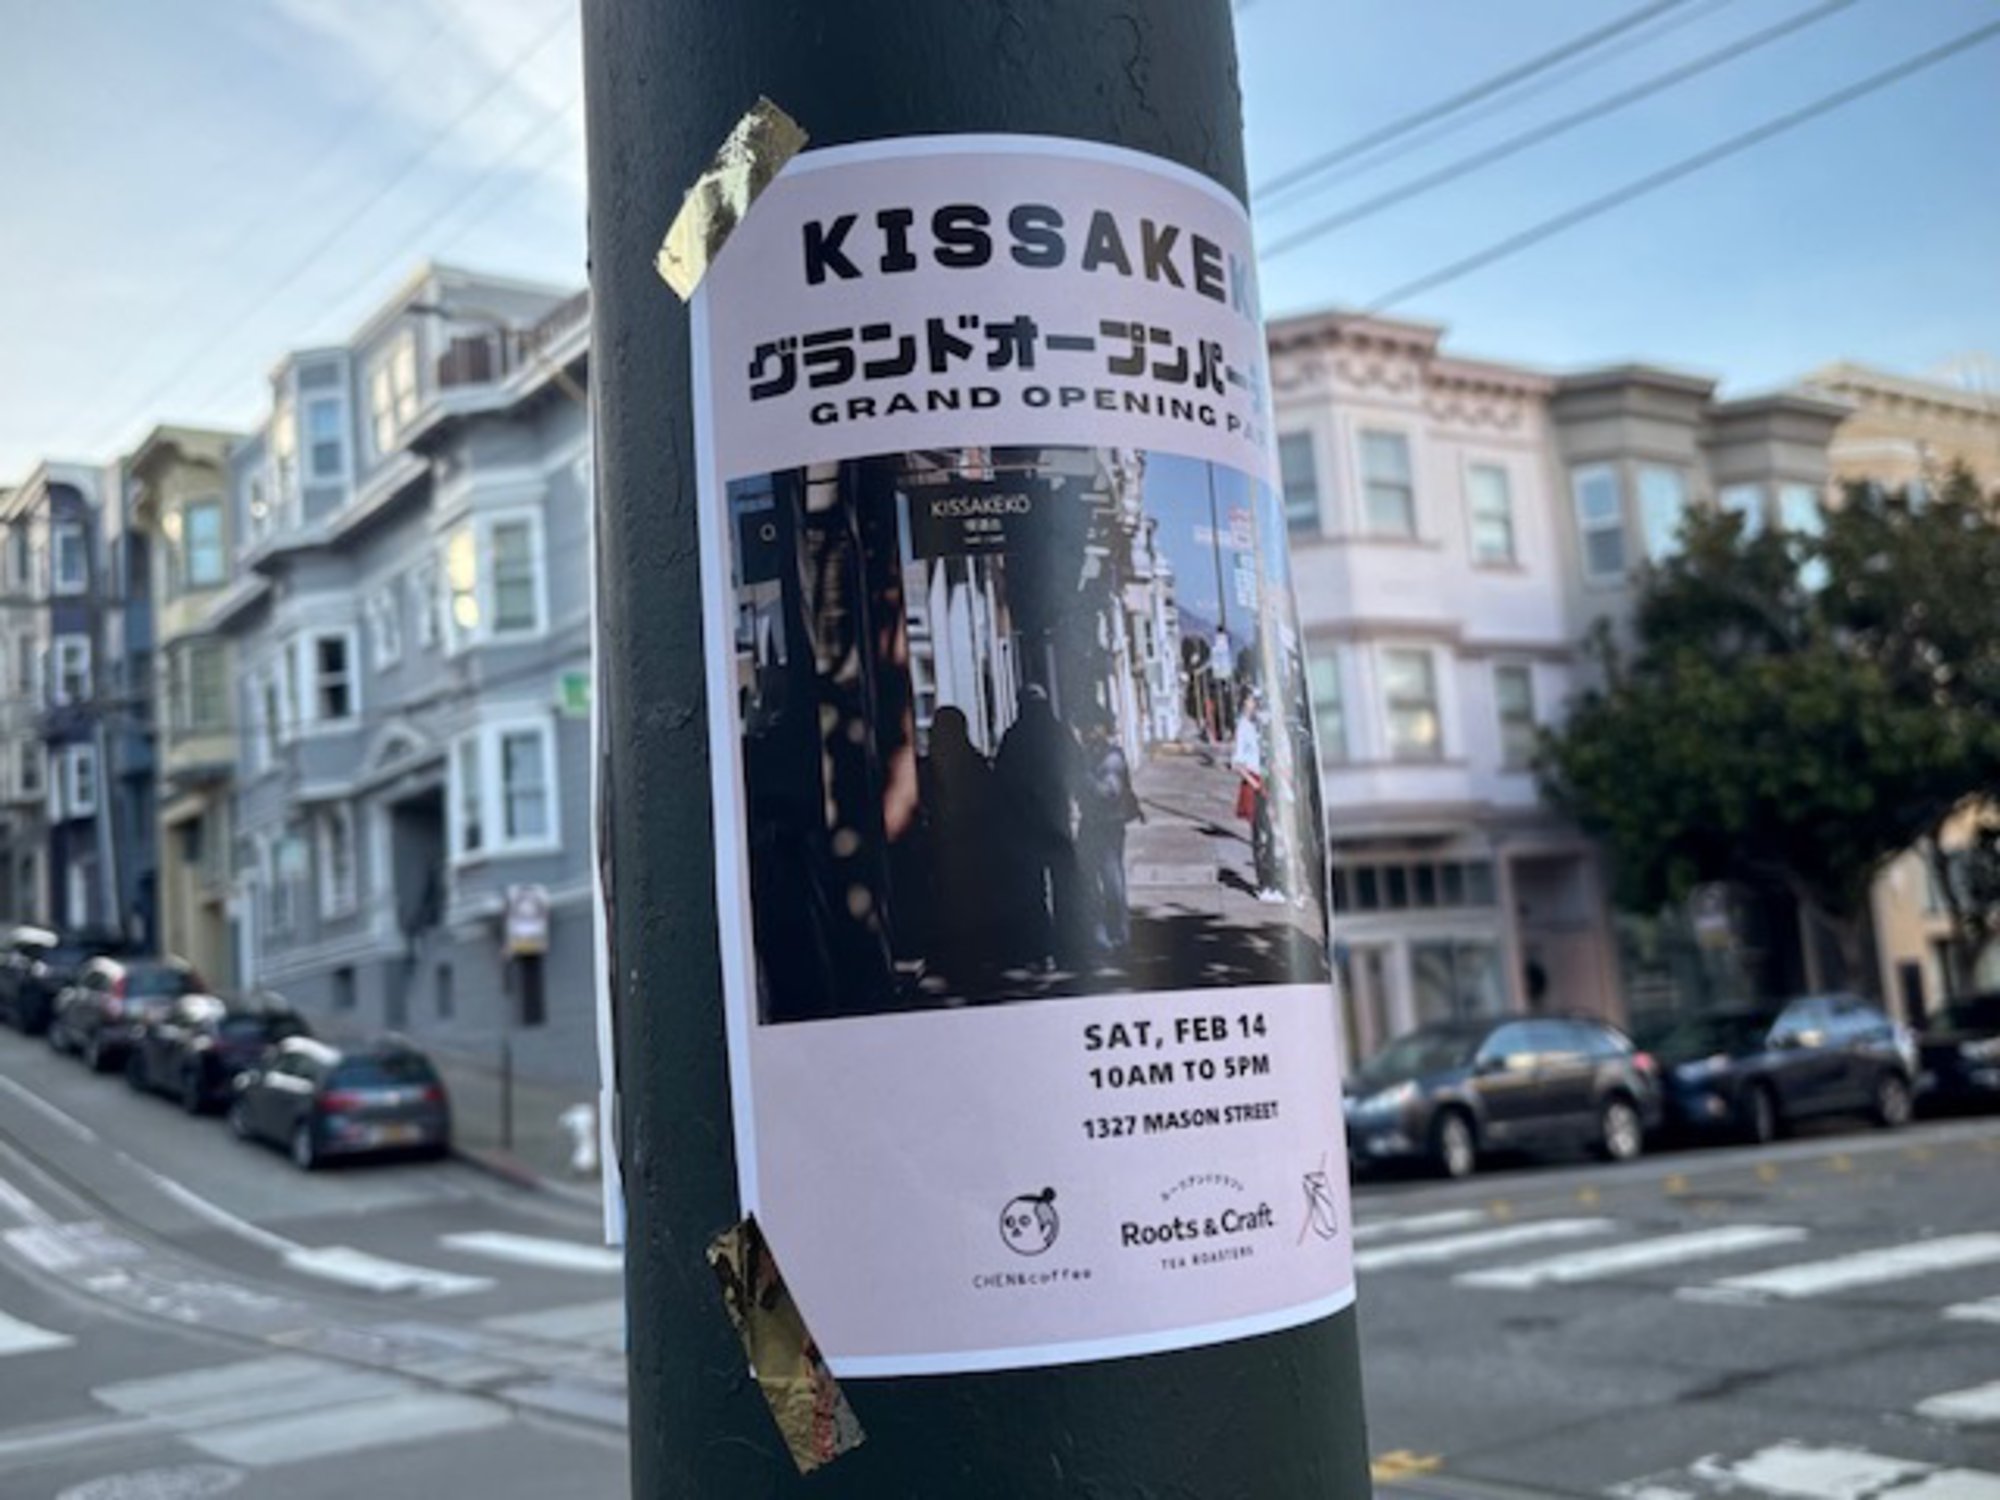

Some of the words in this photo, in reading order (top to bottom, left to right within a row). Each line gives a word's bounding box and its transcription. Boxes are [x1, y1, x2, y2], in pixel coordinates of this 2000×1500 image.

[810, 386, 1001, 426] GRAND
[1021, 386, 1217, 427] OPENING
[931, 493, 1032, 517] KISSAKEKO
[1084, 1020, 1164, 1051] SAT,
[1174, 1015, 1229, 1045] FEB
[1237, 1013, 1267, 1039] 14
[1089, 1061, 1175, 1089] 10AM
[1183, 1057, 1216, 1082] TO
[1224, 1053, 1270, 1079] 5PM
[1083, 1114, 1137, 1139] 1327
[1142, 1106, 1220, 1135] MASON
[1224, 1100, 1279, 1125] STREET
[1121, 1215, 1199, 1247] Roots
[1203, 1217, 1219, 1238] &
[1221, 1201, 1274, 1235] Craft
[1161, 1257, 1187, 1270] TEA
